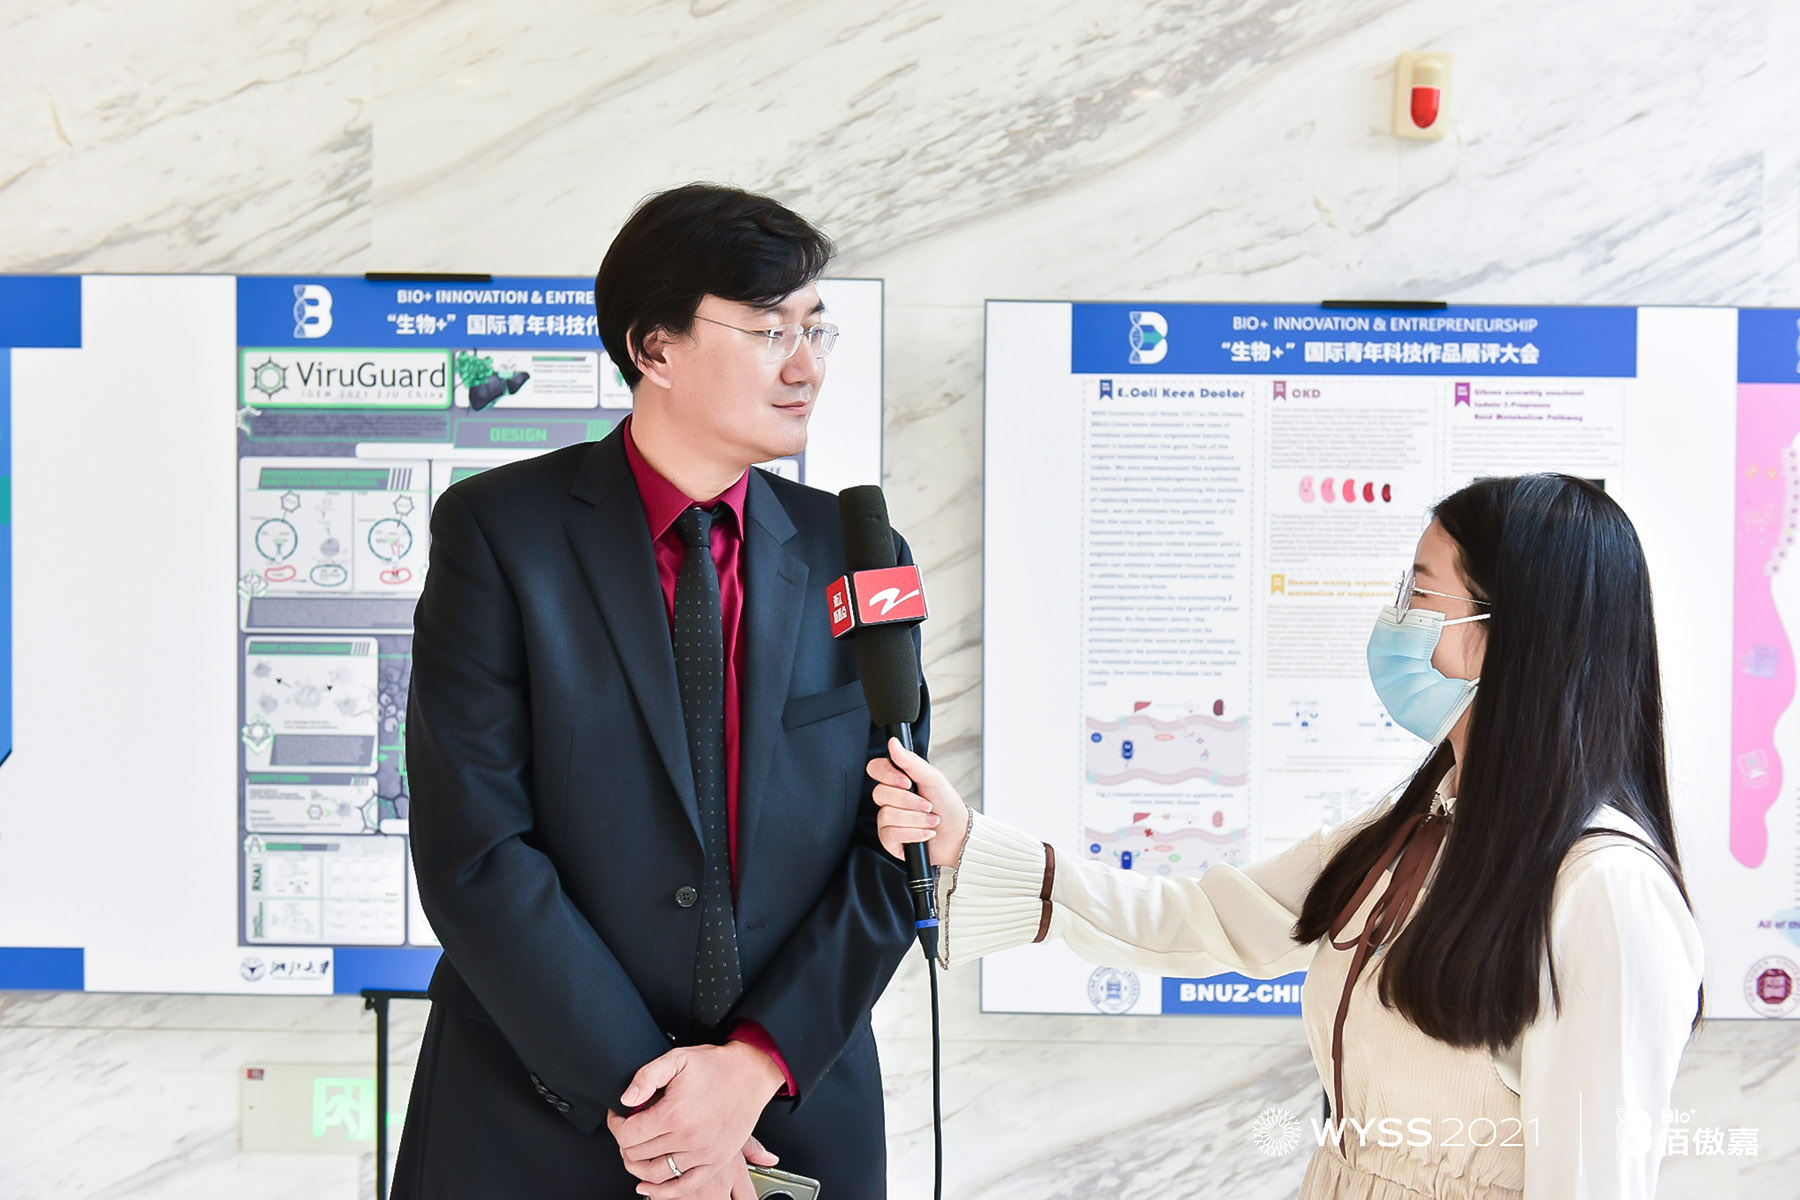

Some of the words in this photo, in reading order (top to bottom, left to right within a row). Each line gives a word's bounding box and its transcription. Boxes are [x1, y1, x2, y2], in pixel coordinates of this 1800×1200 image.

[397, 290, 432, 304] BIO+
[436, 290, 528, 304] INNOVATION
[531, 291, 542, 304] &
[1233, 316, 1268, 331] BIO+
[1274, 316, 1369, 331] INNOVATION
[1373, 317, 1386, 331] &
[1390, 317, 1538, 333] ENTREPRENEURSHIP
[296, 361, 446, 388] ViruGuard
[1200, 388, 1245, 398] Doctor
[490, 427, 547, 443] DESIGN
[1180, 983, 1304, 1004] BNUZ-CHI
